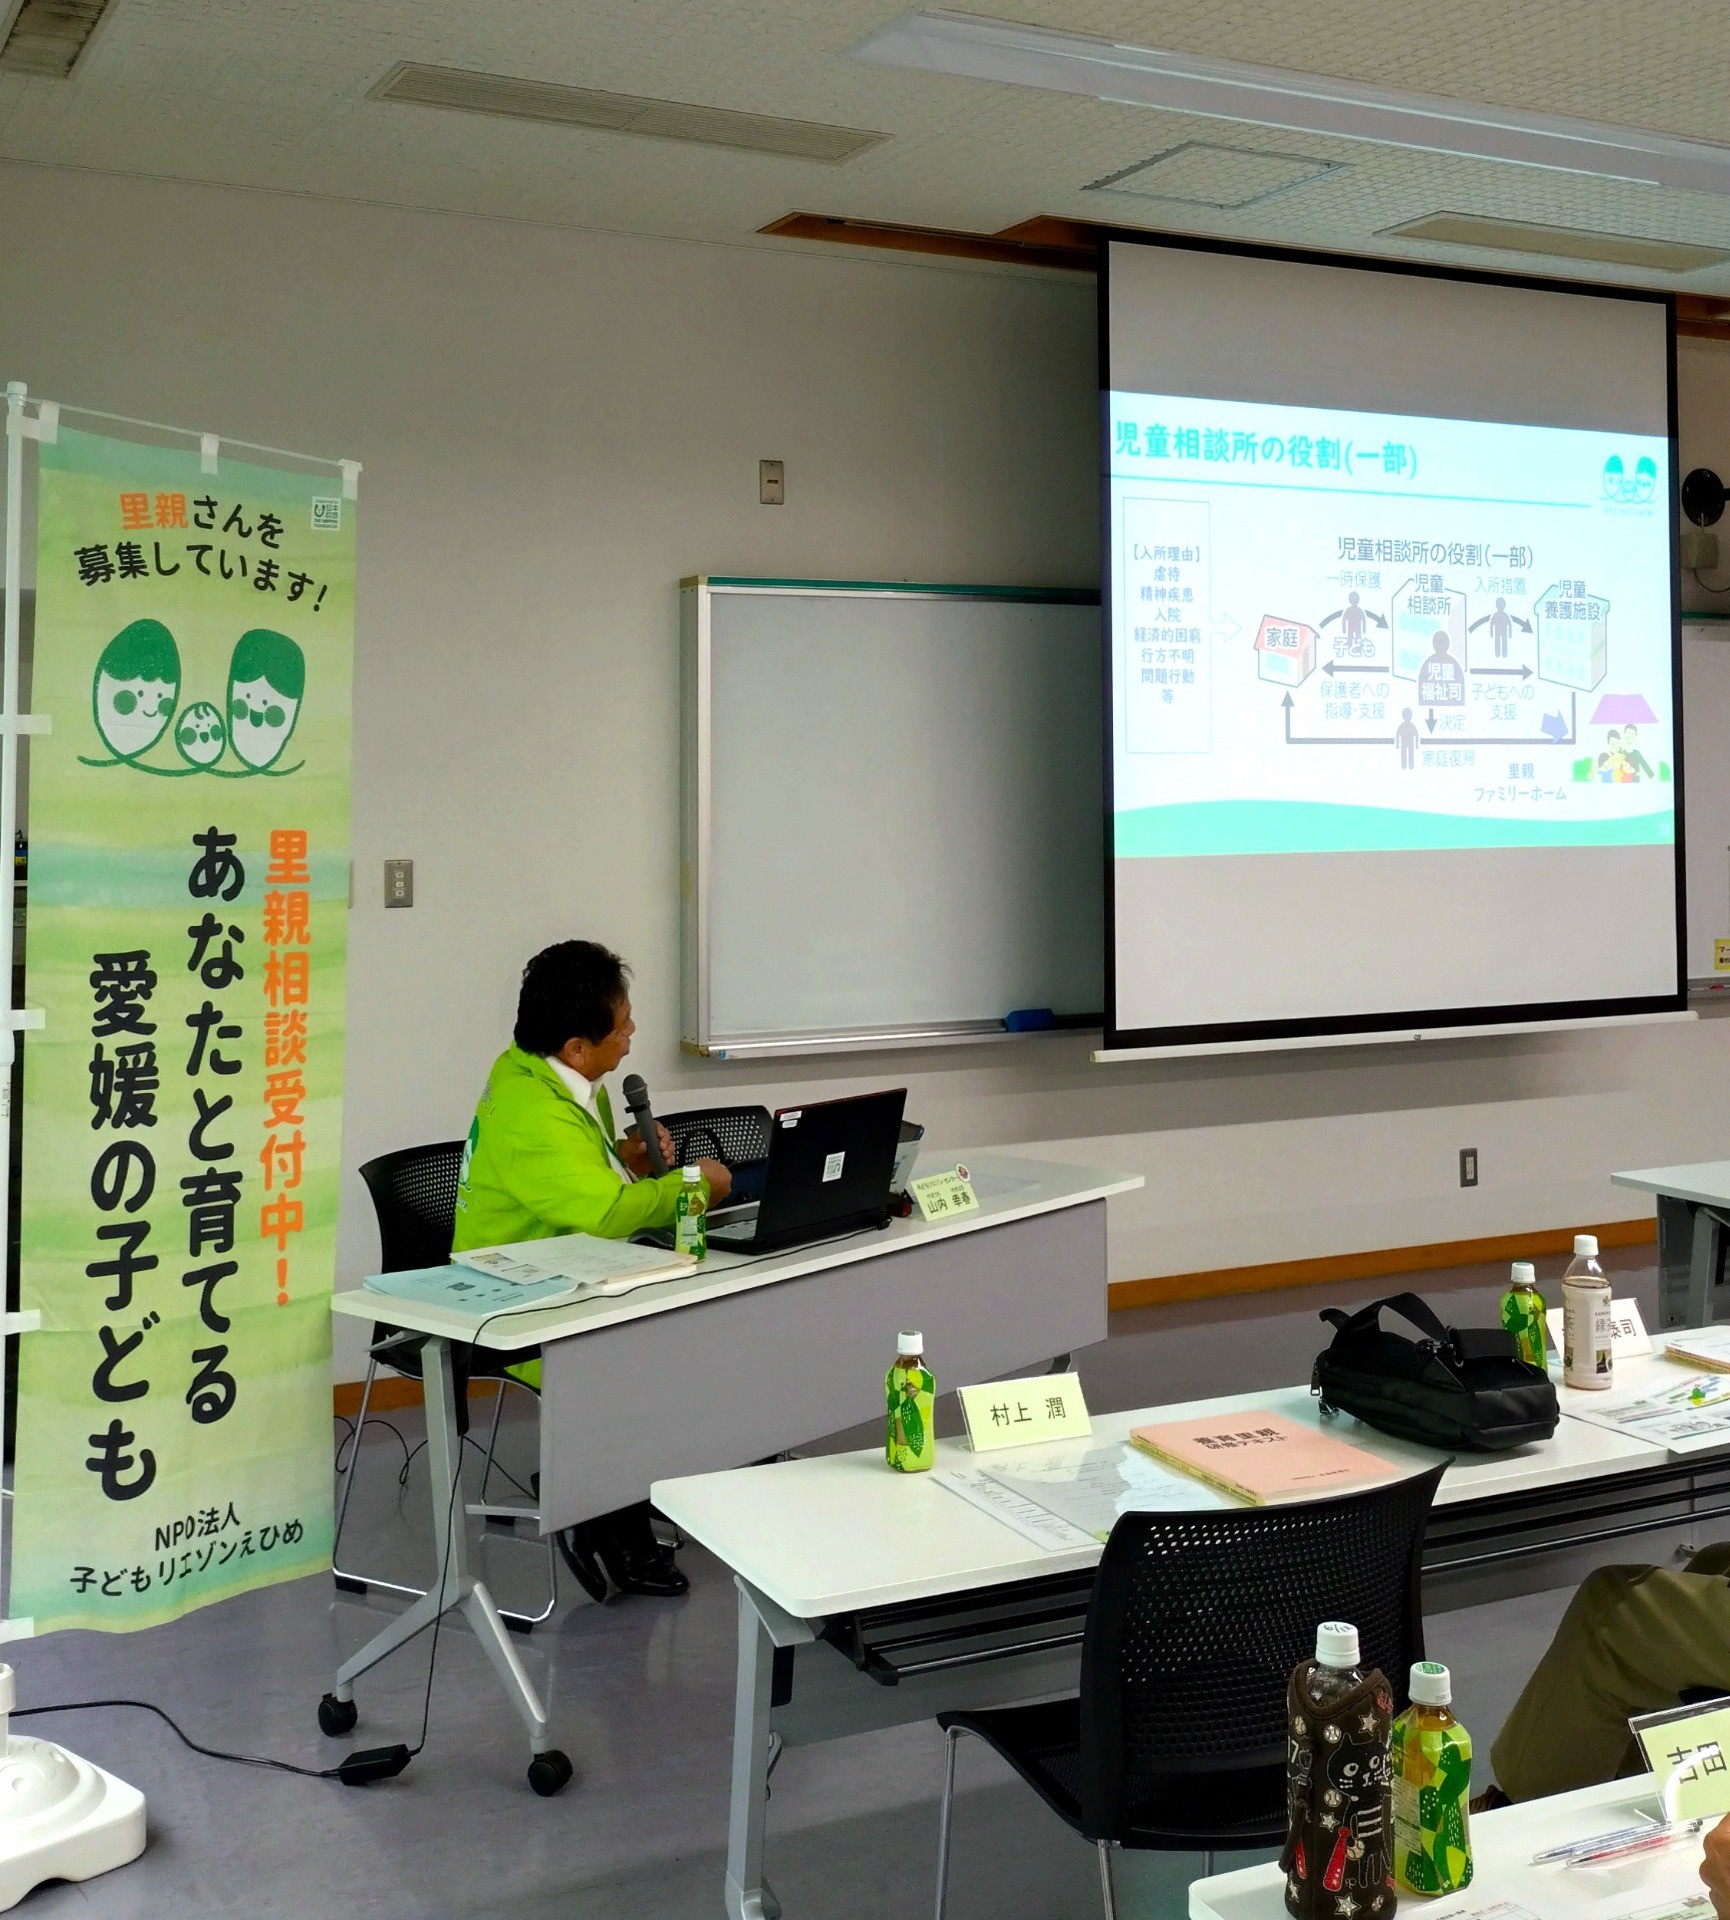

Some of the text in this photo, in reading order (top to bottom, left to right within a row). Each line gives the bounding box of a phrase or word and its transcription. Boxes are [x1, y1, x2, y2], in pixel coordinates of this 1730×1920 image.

[1116, 421, 1417, 480] 児童相談所の役割(一部)
[119, 492, 285, 549] 里親さんを
[1133, 543, 1201, 563] 【入所理由】
[1338, 536, 1534, 569] 児童相談所の役割(一部)
[1154, 565, 1181, 583] 虐待
[1326, 570, 1381, 590] 一時保護
[1415, 573, 1444, 593] 児童
[1474, 576, 1526, 595] 入所措置
[1558, 579, 1587, 599] 児童
[1155, 607, 1181, 624] 入院
[1407, 595, 1451, 616] 相談所
[1545, 600, 1601, 621] 養護施設
[1266, 627, 1298, 648] 家庭
[1333, 636, 1376, 658] 子ども
[1141, 648, 1194, 664] 行方不明
[1141, 667, 1195, 685] 問題行動
[1428, 662, 1456, 681] 児童
[1320, 681, 1389, 699] 保護者への
[1421, 683, 1462, 701] 福祉司
[1471, 683, 1535, 701] 子どもへの
[1490, 703, 1517, 721] 支援
[1439, 714, 1466, 731] 決定
[1422, 750, 1475, 767] 家庭復帰
[1508, 763, 1535, 780] 里親
[1474, 785, 1567, 803] ファミリーホーム
[180, 826, 245, 1425] あなたと育てる
[927, 1198, 948, 1214] 山内
[86, 949, 161, 1502] 愛媛の子ども
[990, 1396, 1066, 1427] 村上 潤
[155, 1502, 241, 1552] NPO法人
[70, 1519, 304, 1597] 子どもリエゾンえひめ
